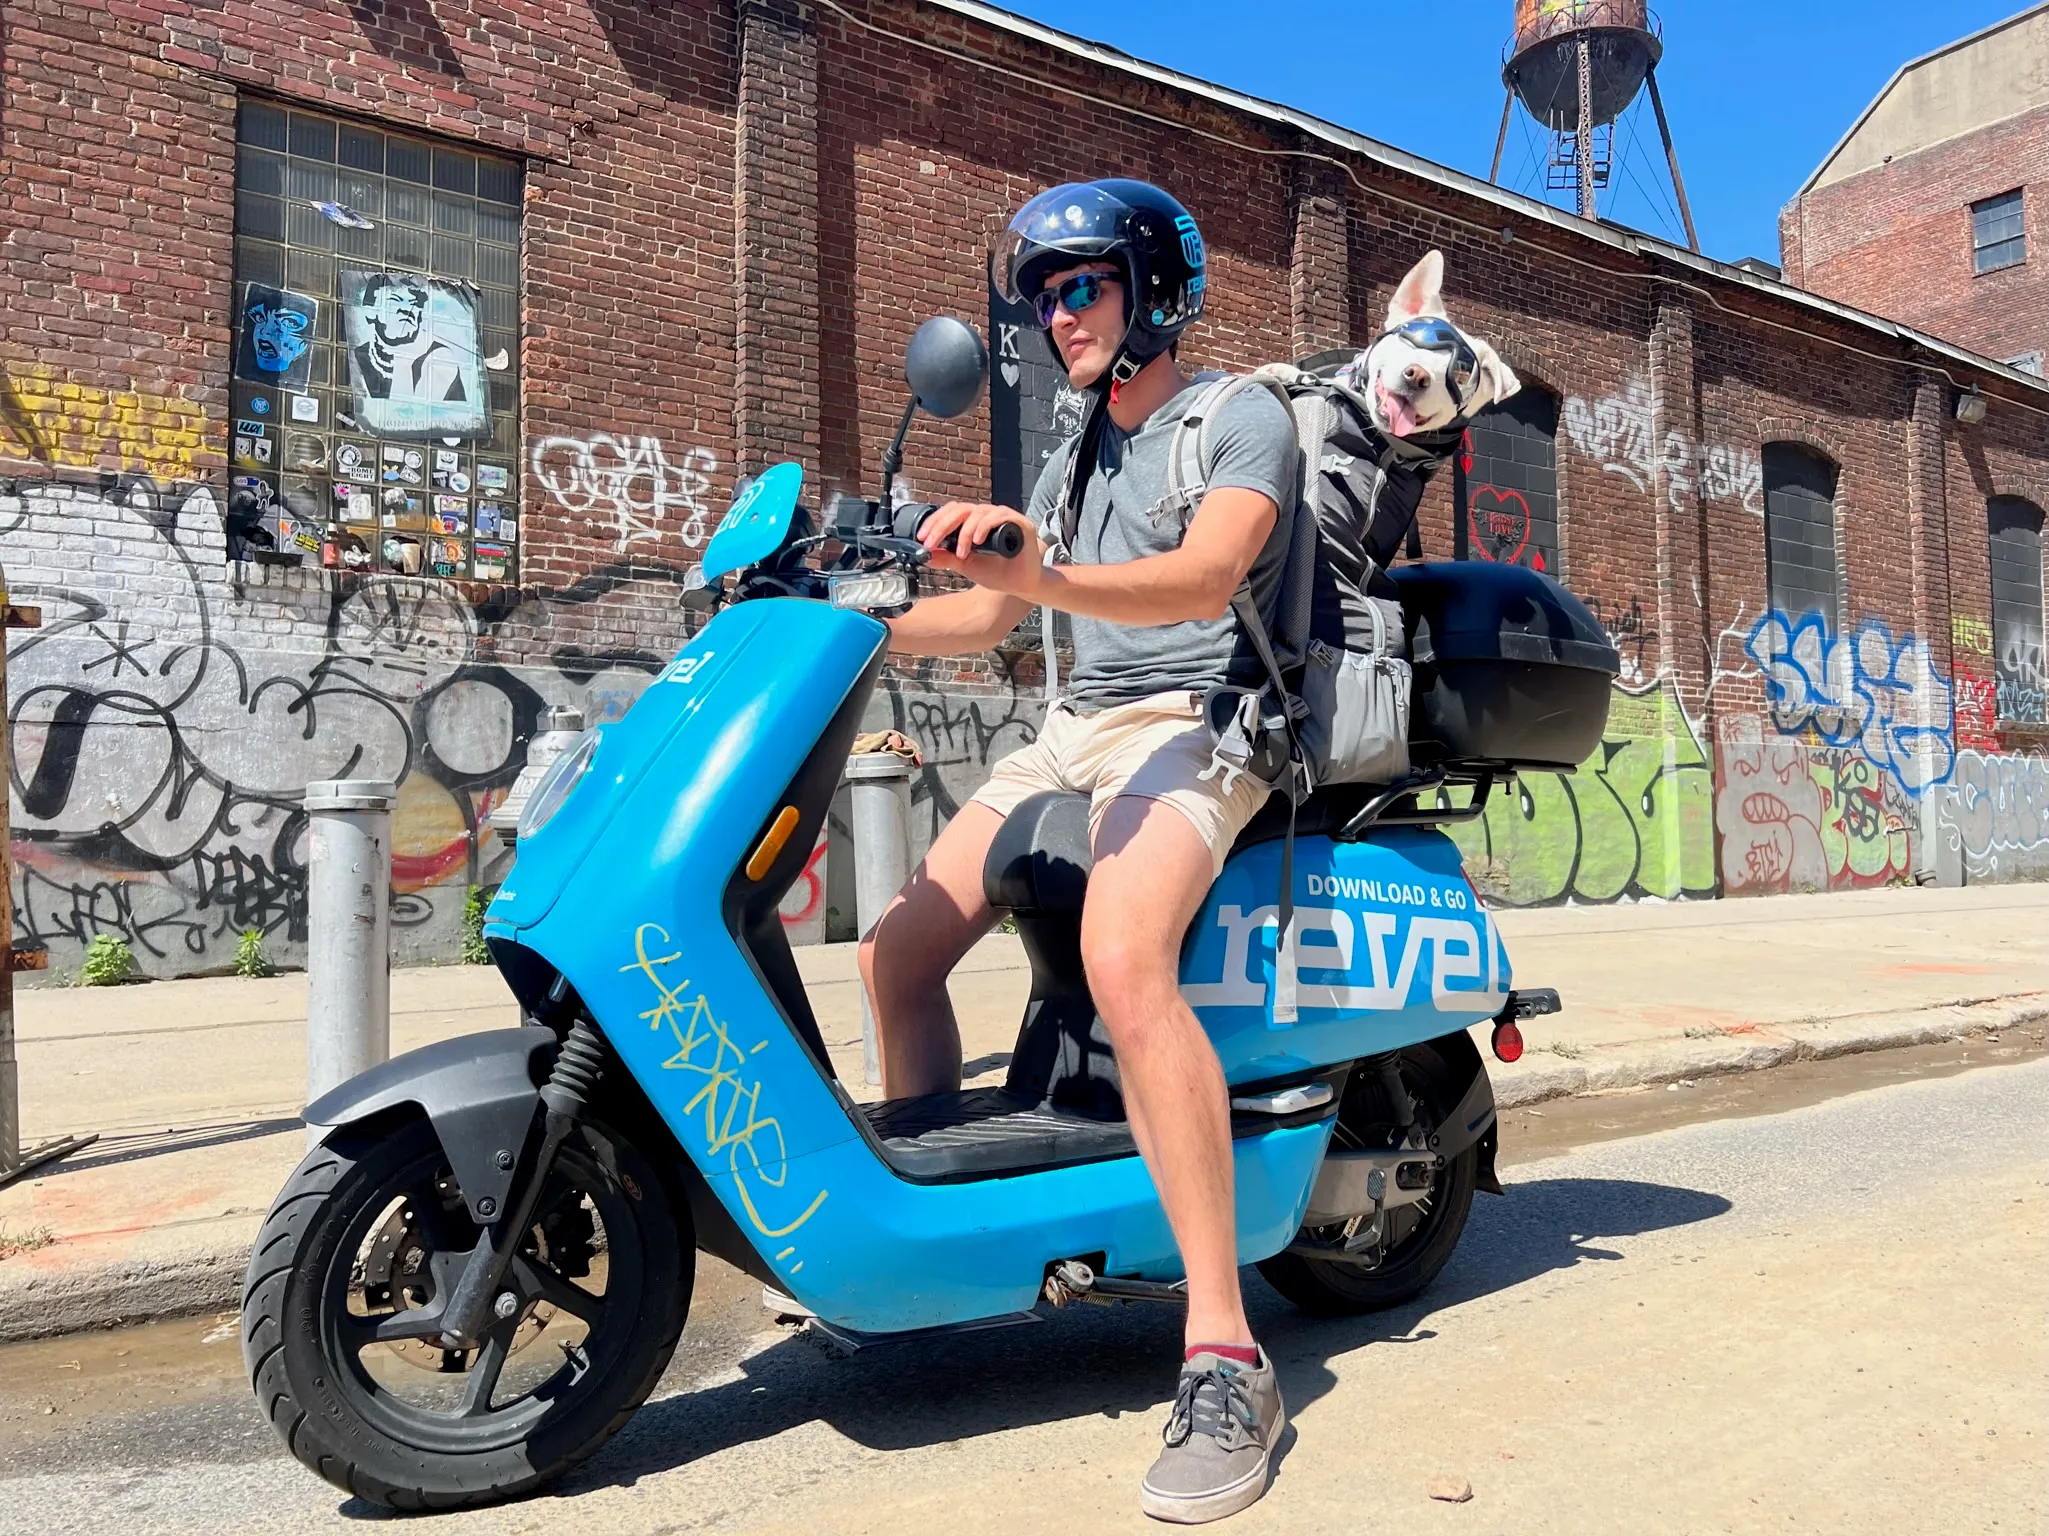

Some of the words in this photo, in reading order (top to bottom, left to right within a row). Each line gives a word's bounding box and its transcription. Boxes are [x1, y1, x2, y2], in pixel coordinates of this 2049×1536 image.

[999, 323, 1020, 360] K
[1307, 874, 1426, 906] DOWNLOAD
[1430, 886, 1443, 908] &
[1444, 888, 1467, 911] GO
[1182, 903, 1512, 1012] revel
